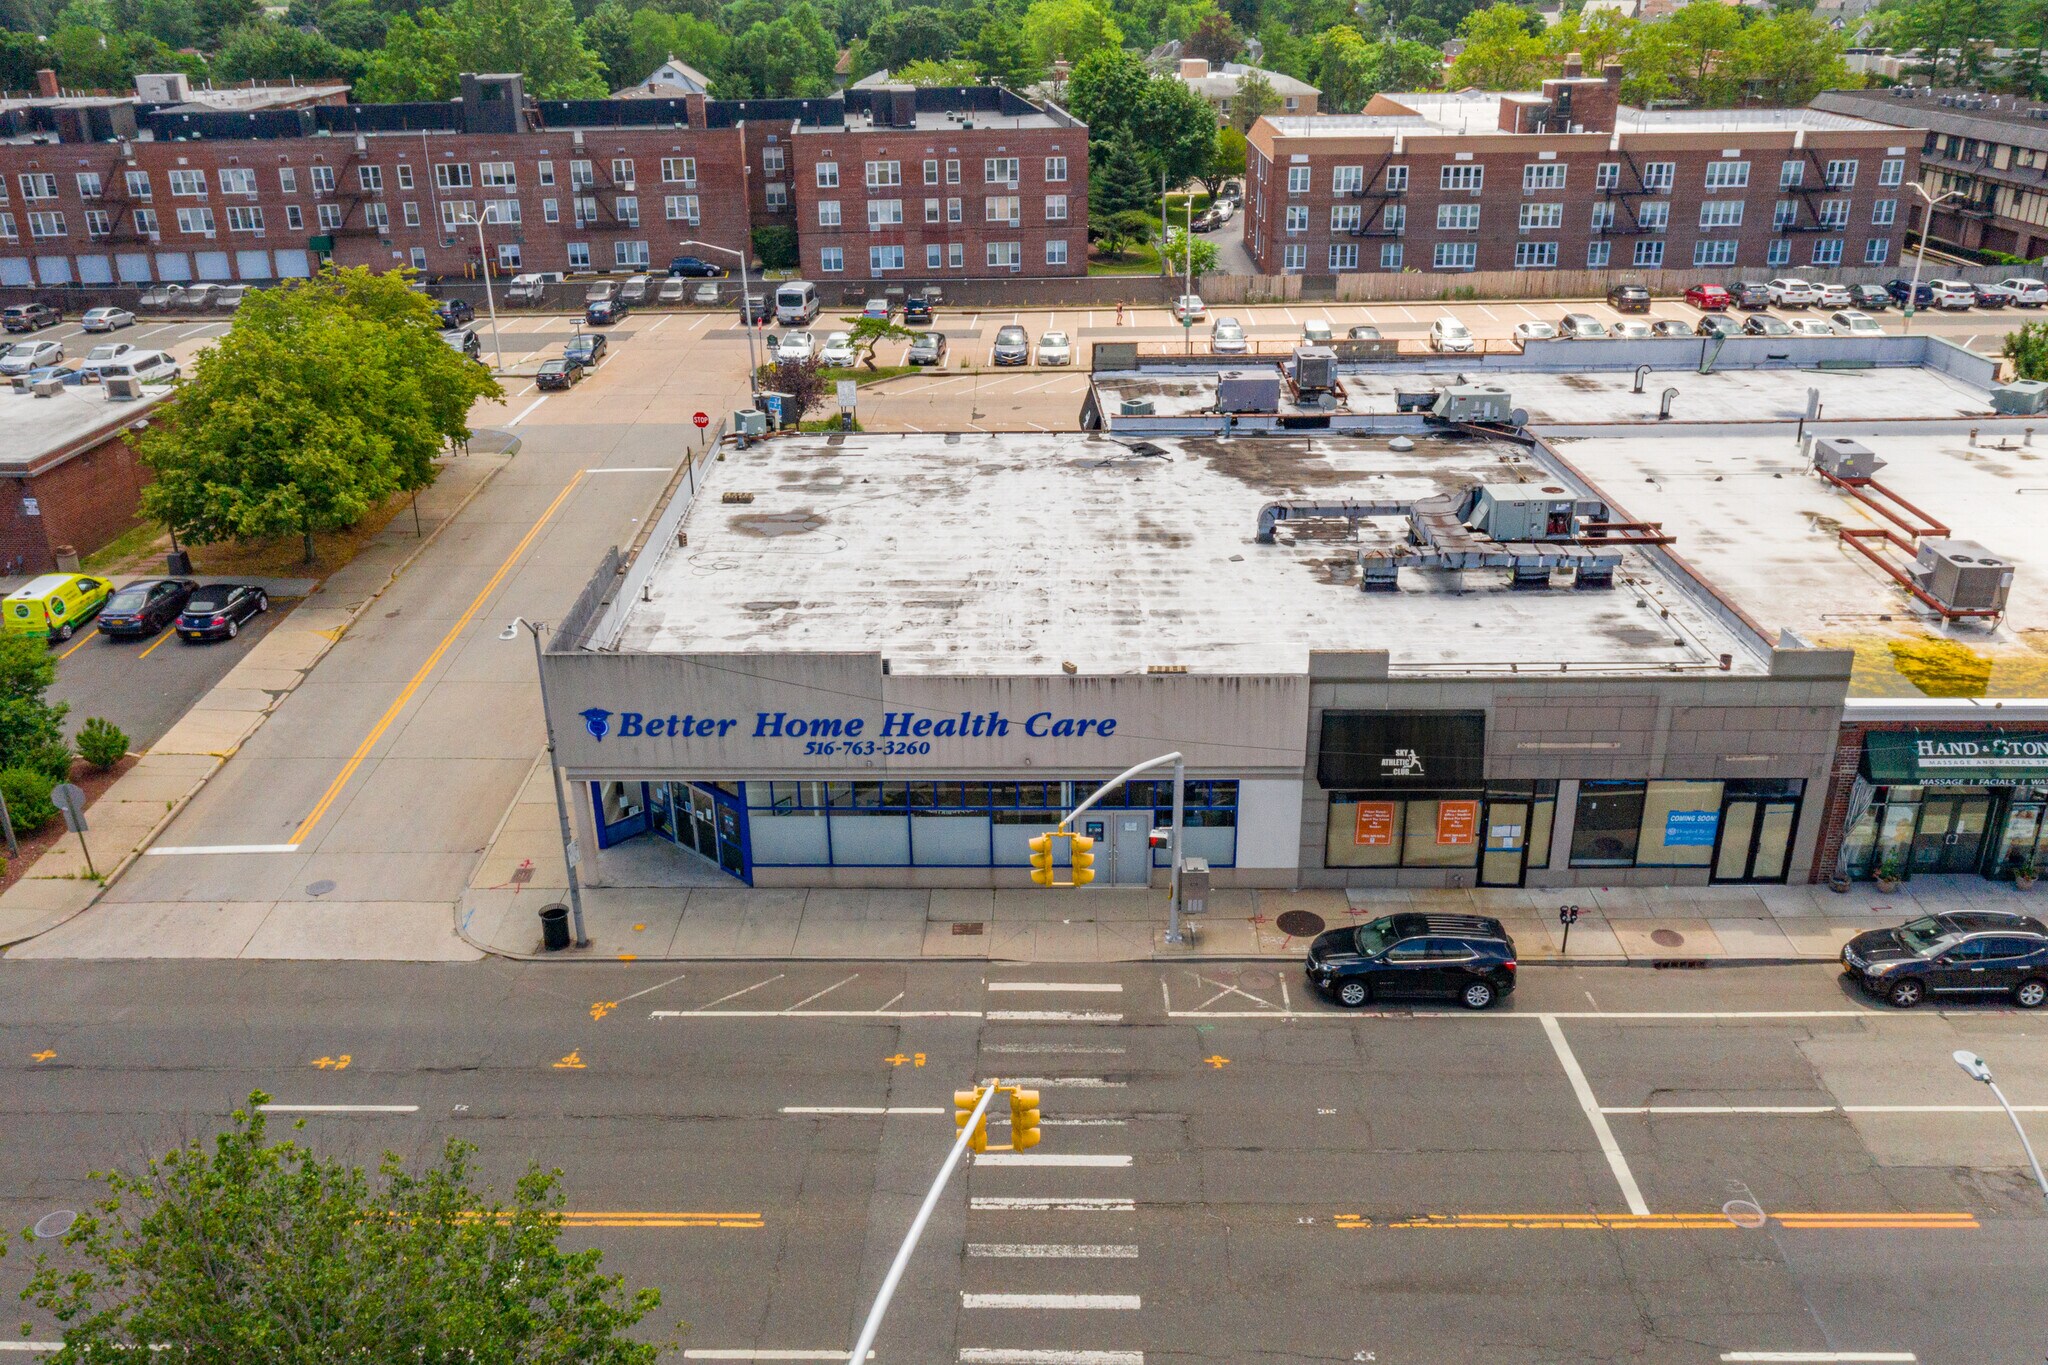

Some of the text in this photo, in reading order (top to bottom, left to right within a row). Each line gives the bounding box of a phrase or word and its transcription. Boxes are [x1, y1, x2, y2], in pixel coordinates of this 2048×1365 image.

[618, 711, 1117, 737] Better Home Health Care
[804, 741, 930, 756] 516-763-3260
[1917, 740, 1978, 755] HAND
[1381, 758, 1410, 766] ATHLETIC
[1393, 768, 1410, 776] CLUB
[1920, 778, 2048, 786] MASSAGE FACIALS WA
